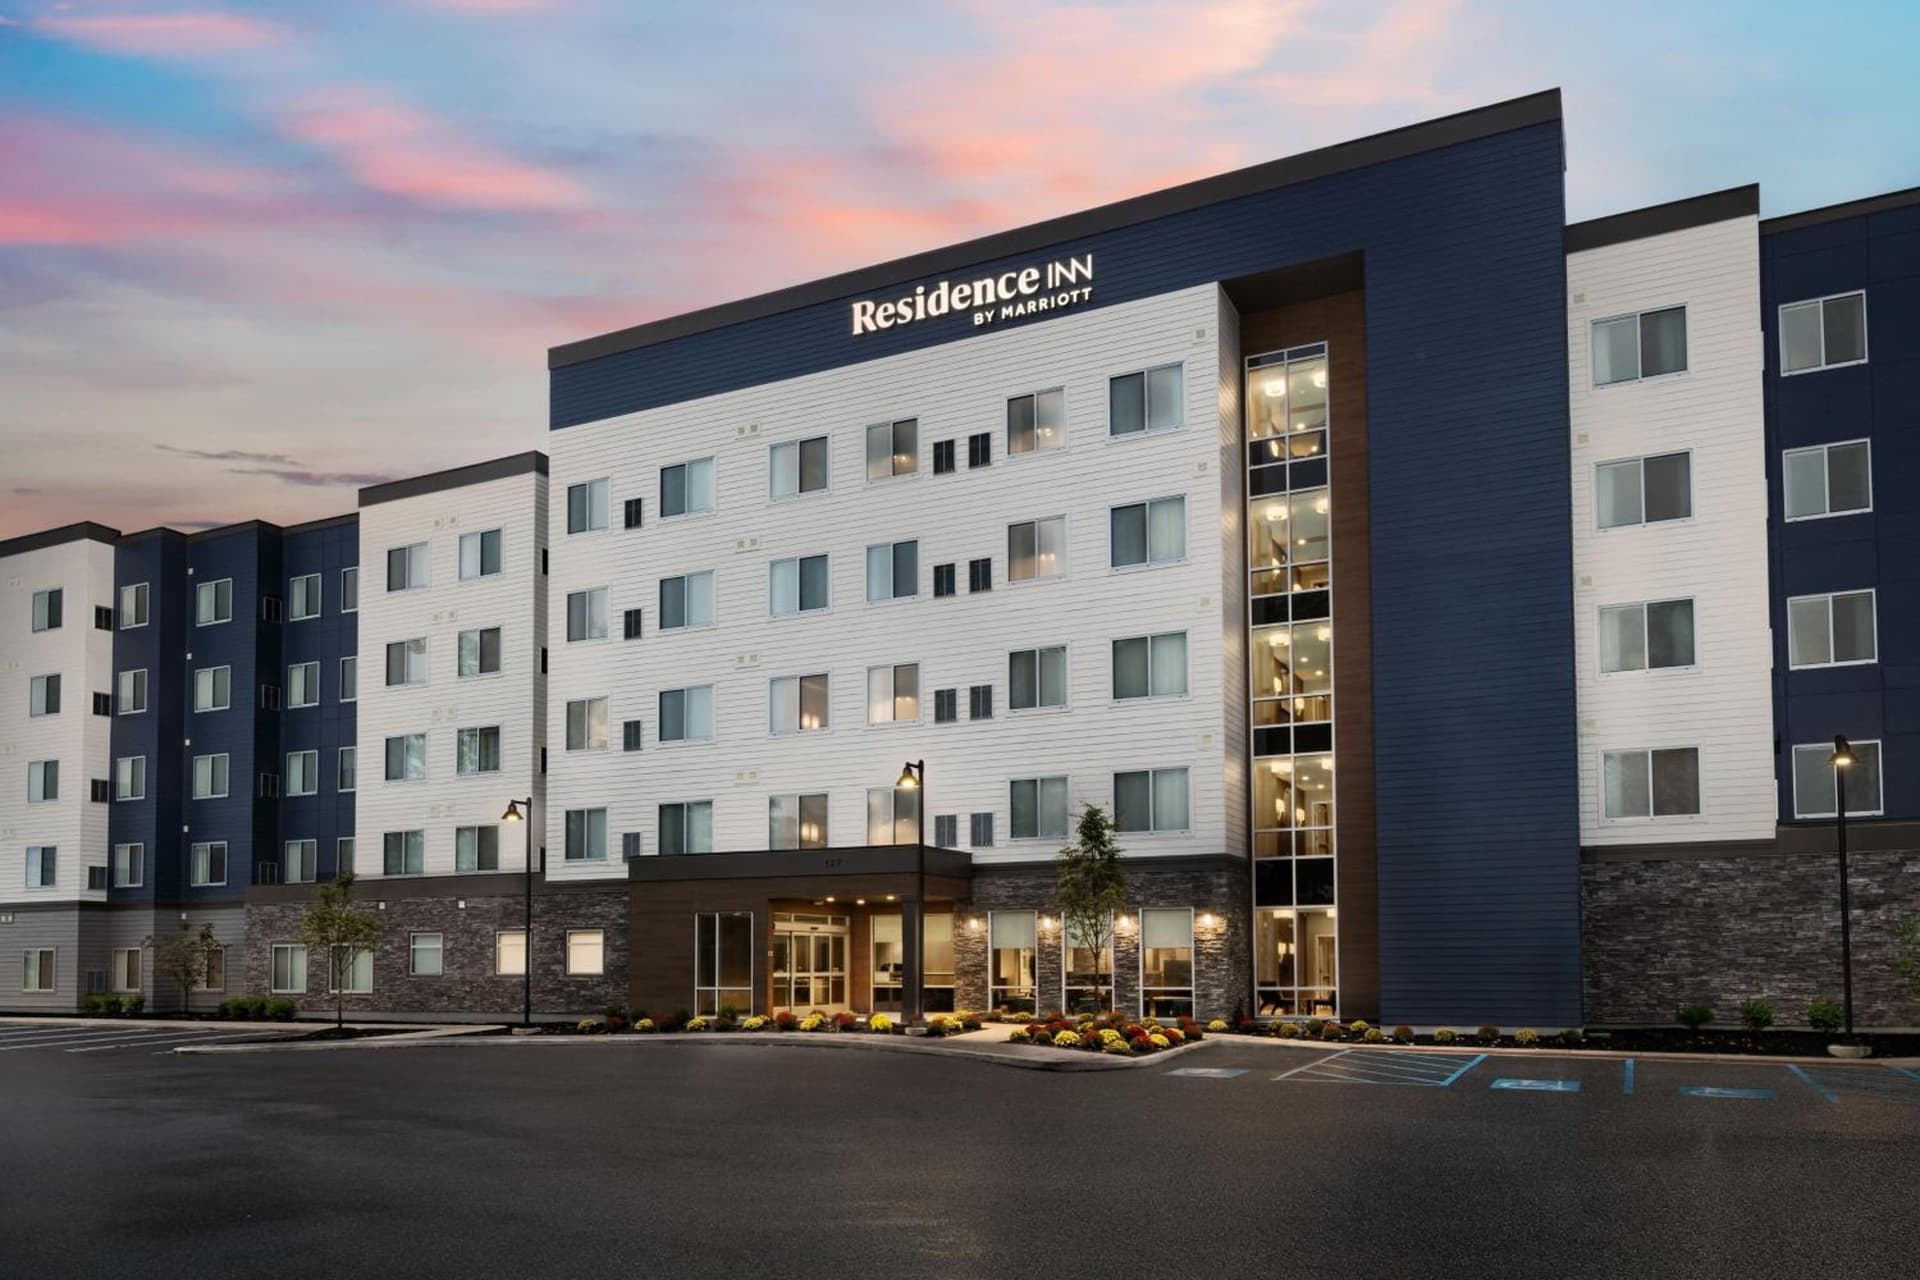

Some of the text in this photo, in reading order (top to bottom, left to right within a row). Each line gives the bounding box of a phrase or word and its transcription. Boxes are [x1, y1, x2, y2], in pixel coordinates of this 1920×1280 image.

[851, 253, 1093, 336] Residence INN
[973, 287, 1093, 326] BY MARRIOTT
